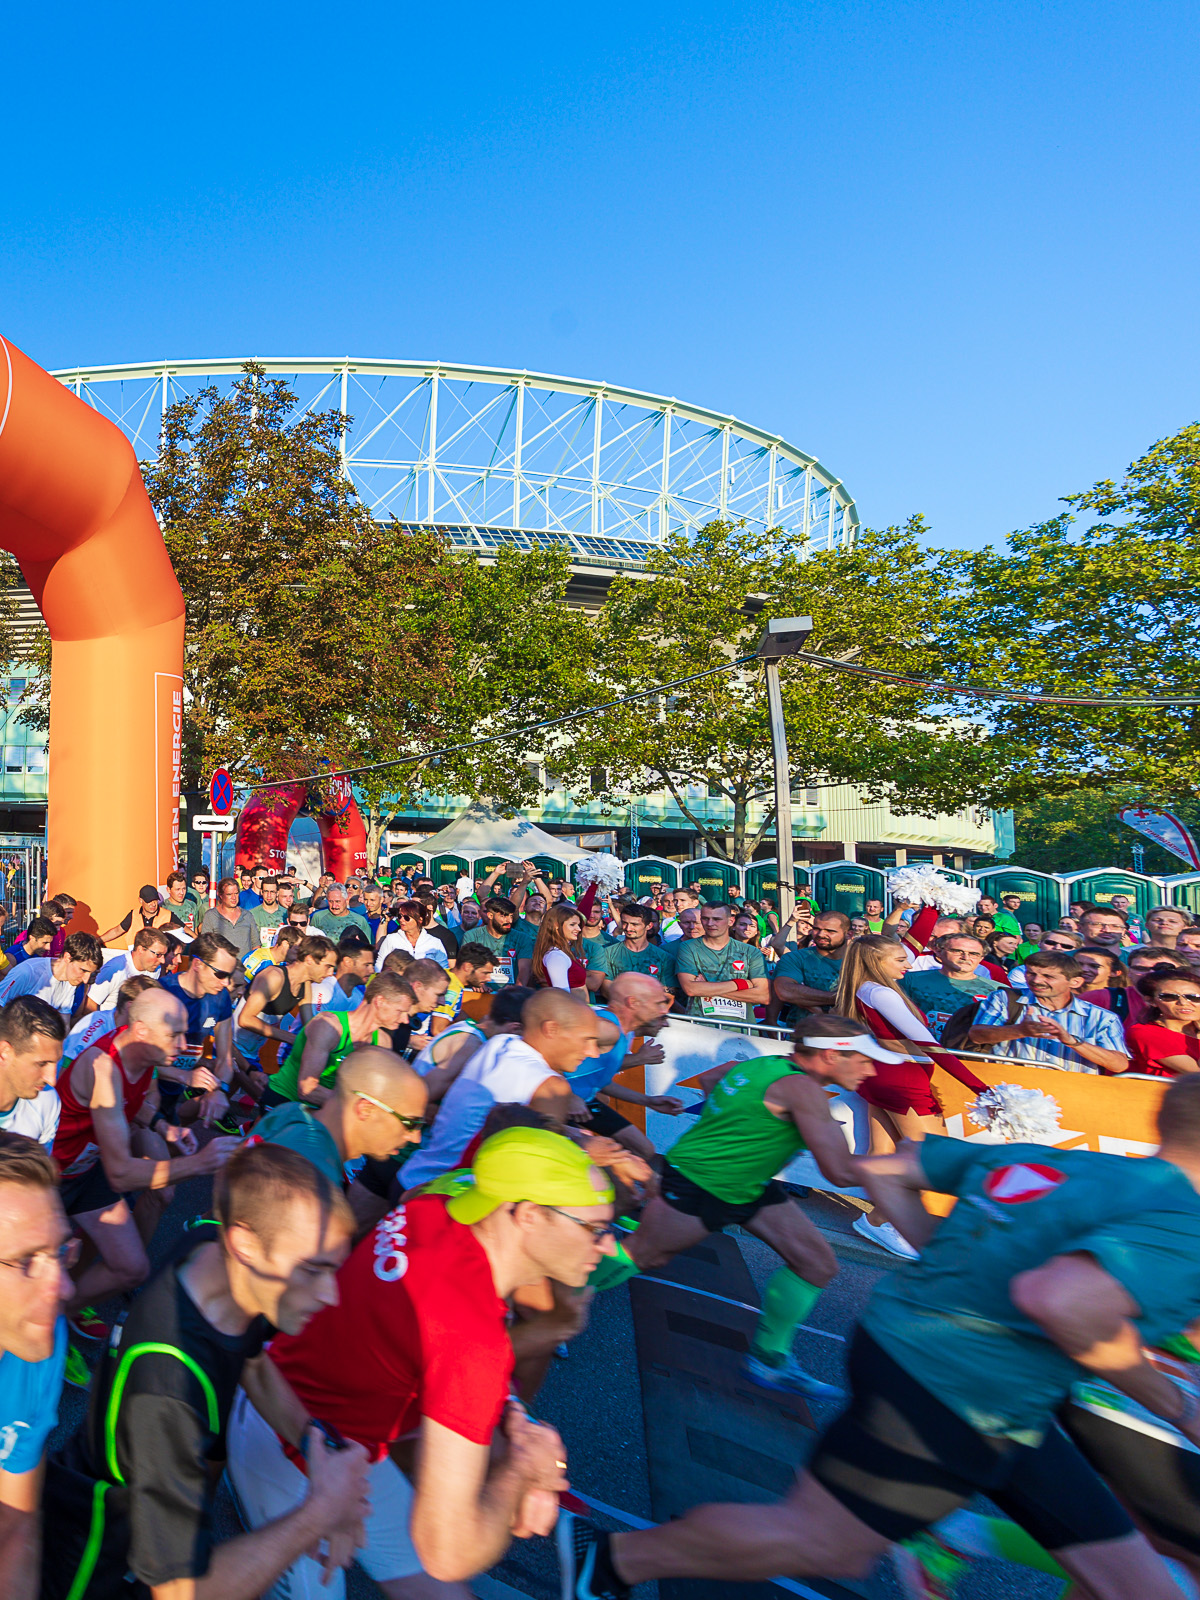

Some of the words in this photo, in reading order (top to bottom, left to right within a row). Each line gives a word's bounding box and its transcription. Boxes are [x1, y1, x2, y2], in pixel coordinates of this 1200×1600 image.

[171, 690, 182, 798] ENERGIE
[171, 806, 180, 872] WIEN
[269, 849, 287, 859] STO
[713, 998, 743, 1009] 11143B
[81, 1018, 105, 1043] BOSCH
